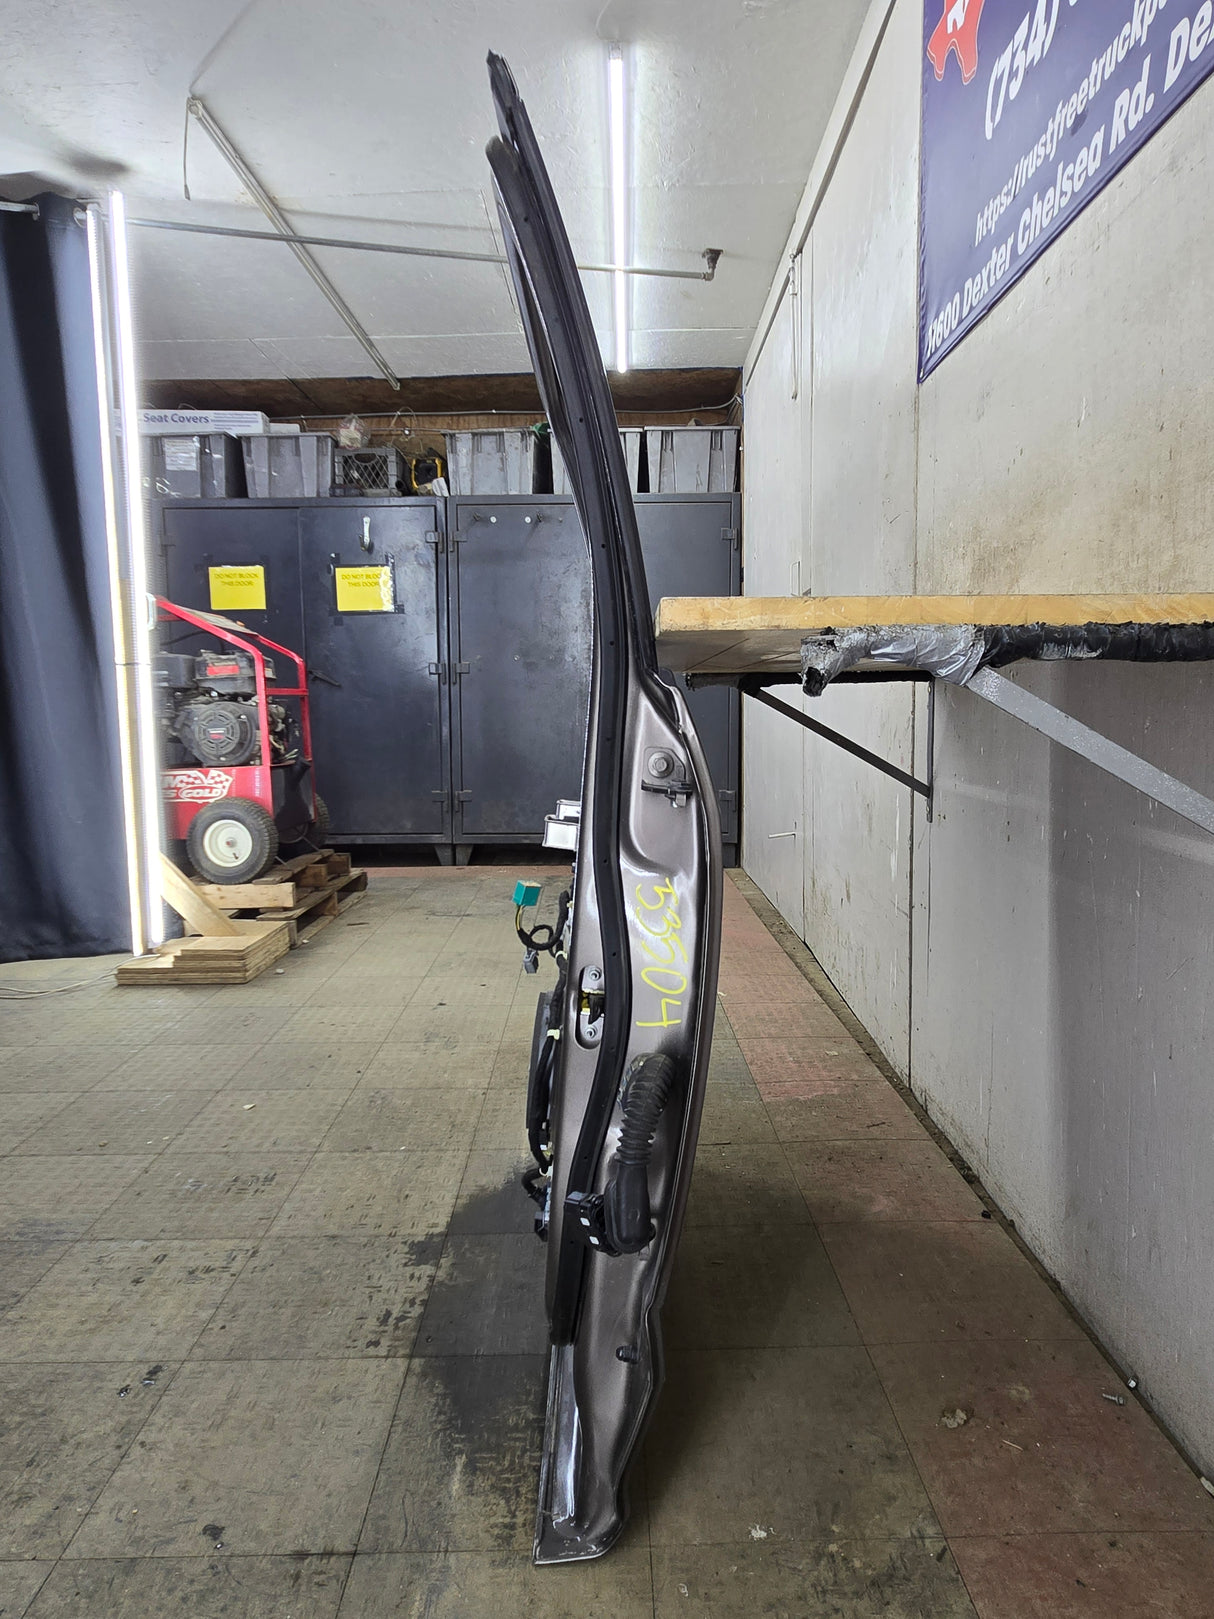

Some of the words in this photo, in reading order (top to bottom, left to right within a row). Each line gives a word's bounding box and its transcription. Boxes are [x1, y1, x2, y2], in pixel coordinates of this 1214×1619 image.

[962, 231, 1015, 320] Dexter
[1017, 124, 1105, 256] Chelsea
[1108, 53, 1155, 155] Rd.
[975, 0, 1167, 248] https://rustfreetruckp
[143, 412, 169, 423] Seat
[170, 413, 210, 424] Covers
[181, 788, 222, 798] GOLD
